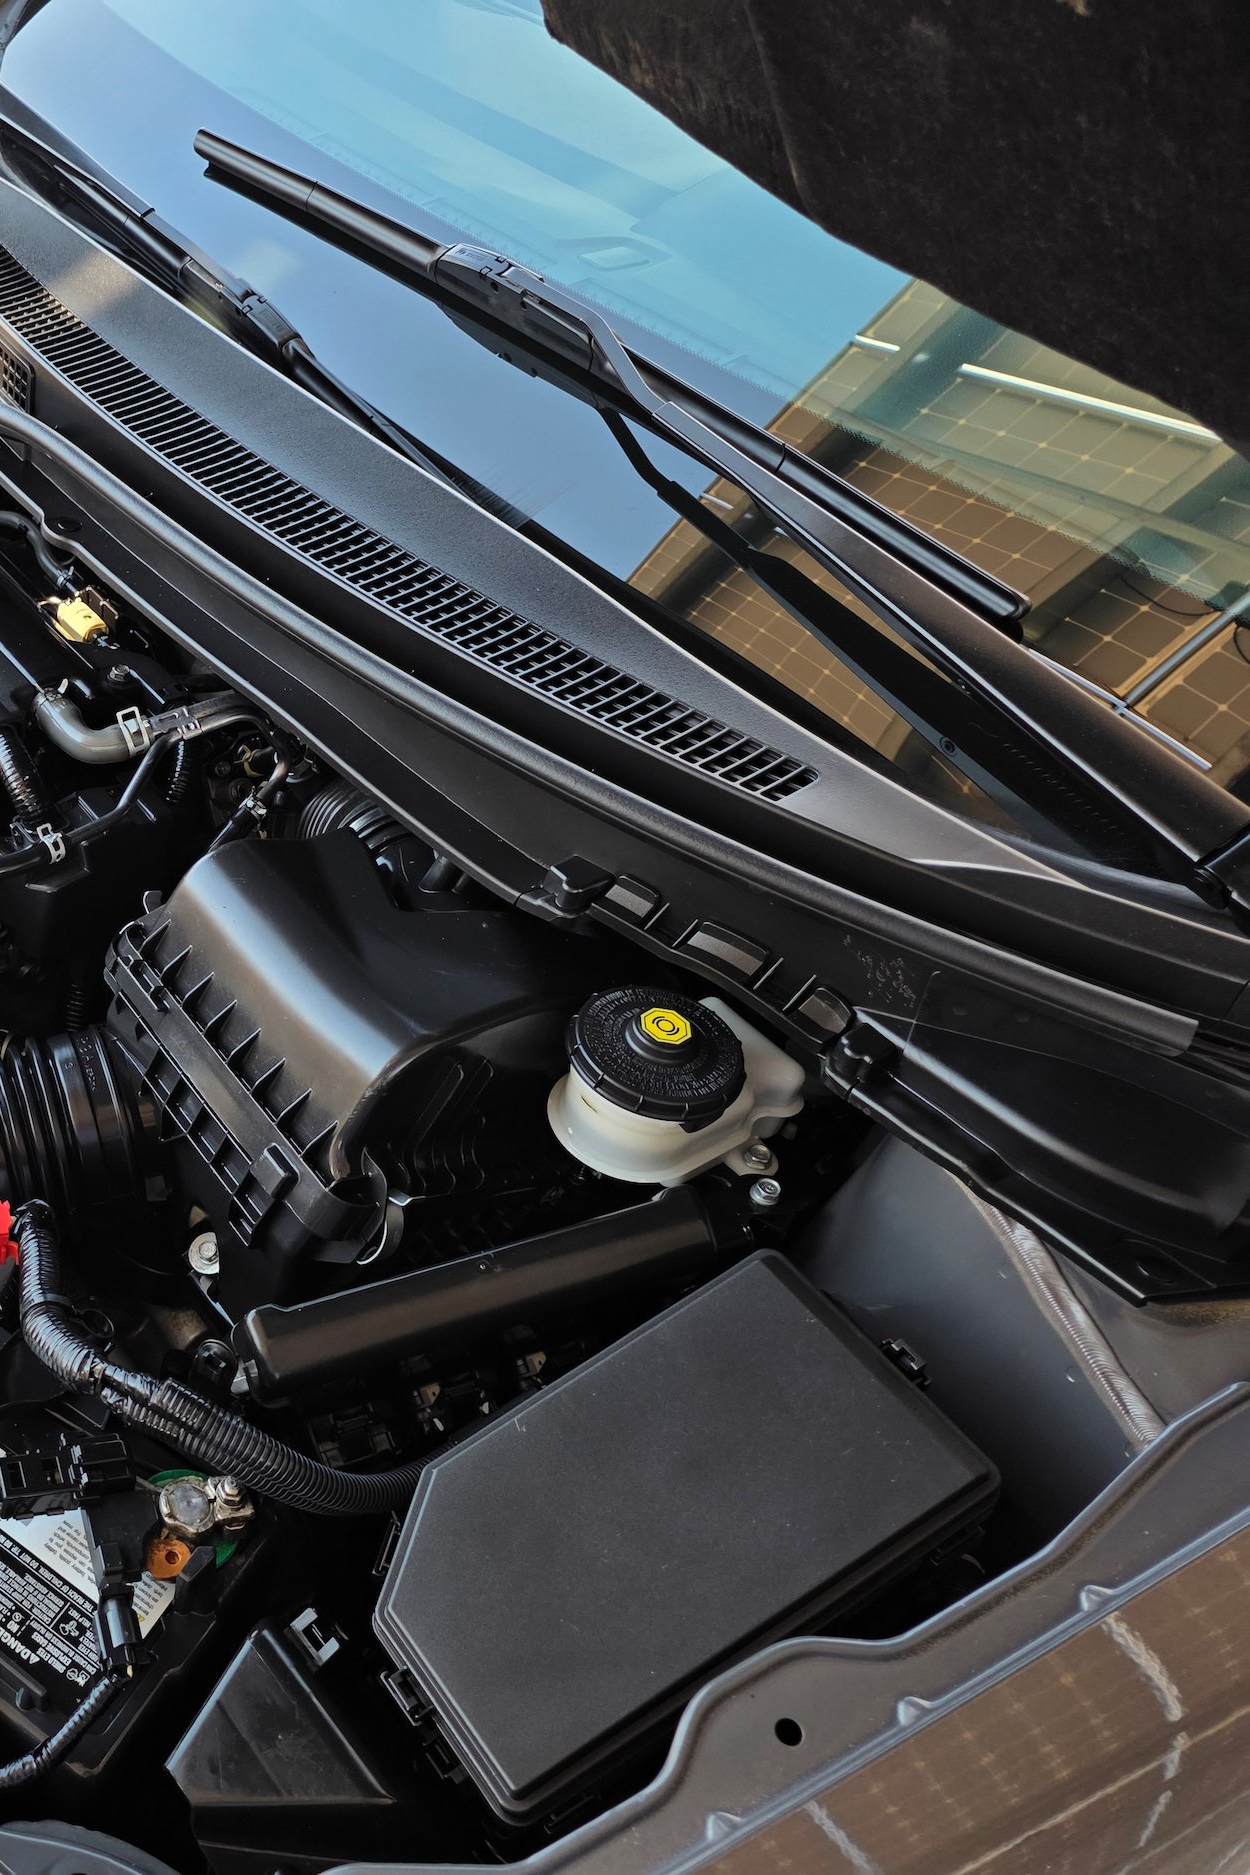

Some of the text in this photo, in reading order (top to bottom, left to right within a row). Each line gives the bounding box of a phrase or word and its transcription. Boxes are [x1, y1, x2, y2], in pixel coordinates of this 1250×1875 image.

[2, 1538, 13, 1548] DO
[9, 1543, 22, 1555] TIP.
[19, 1551, 32, 1564] NOT
[28, 1558, 39, 1569] DO
[36, 1564, 63, 1588] CHILDREN.
[6, 1577, 24, 1593] VEHICLE
[23, 1582, 35, 1593] NOT
[60, 1583, 70, 1593] OF
[10, 1589, 25, 1603] JUMP
[35, 1591, 45, 1601] OR
[46, 1590, 65, 1607] SERVICE
[66, 1588, 85, 1605] REACH
[21, 1598, 32, 1609] FOR
[26, 1593, 56, 1618] INSTRUCTIONS
[42, 1596, 60, 1613] MANUAL
[81, 1600, 94, 1612] THE
[66, 1606, 92, 1628] HELP FAST.
[5, 1619, 20, 1633] NO
[29, 1618, 97, 1675] CAN CAUSE BLINDNESS OR INJURY
[30, 1630, 72, 1666] EXPLOSIVE GASES
[77, 1642, 90, 1655] EYES
[35, 1646, 66, 1673] SHIELD EYES
